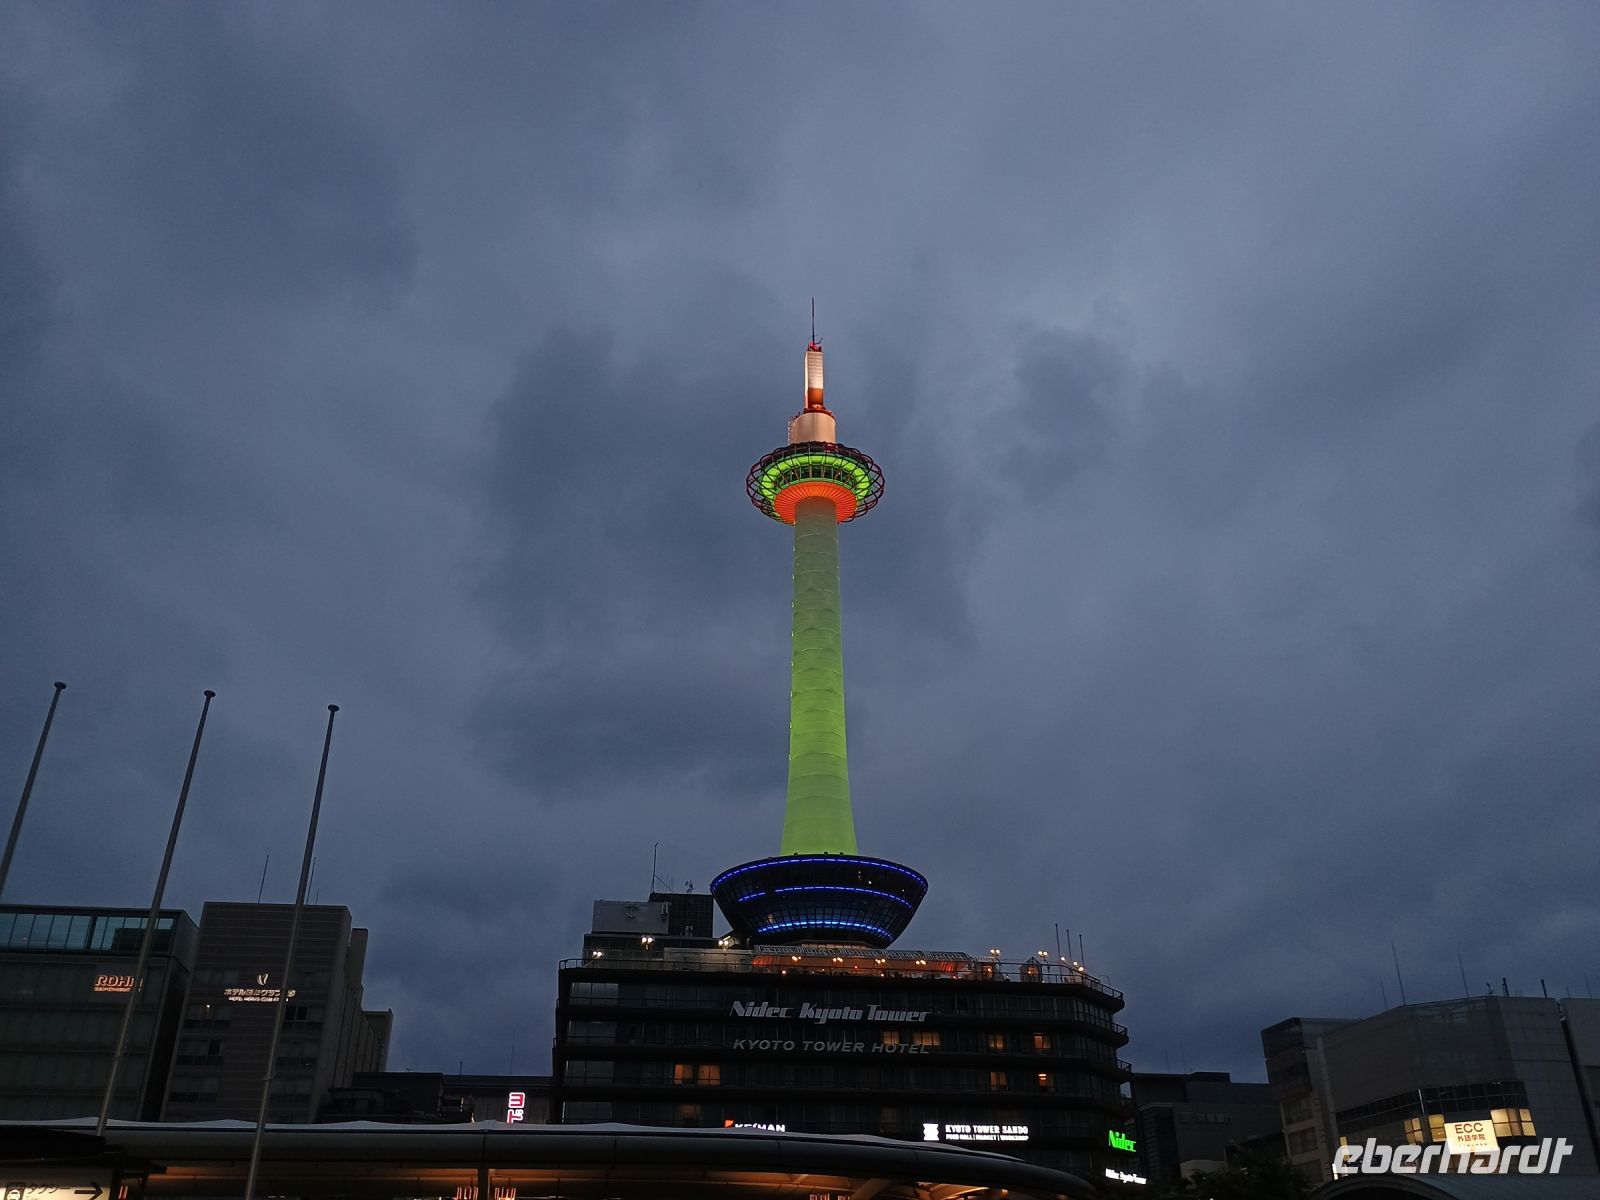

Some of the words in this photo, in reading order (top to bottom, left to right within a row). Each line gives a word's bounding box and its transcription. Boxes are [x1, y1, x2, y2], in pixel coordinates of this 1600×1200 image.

[729, 1000, 794, 1018] Nidec
[799, 1002, 863, 1024] Kyoto
[867, 1004, 931, 1022] Tower
[733, 1039, 795, 1051] KYOTO
[802, 1041, 864, 1053] TOWER
[871, 1043, 929, 1055] HOTEL
[945, 1125, 971, 1133] KYOTO
[973, 1125, 1000, 1133] TOWER
[1002, 1126, 1028, 1134] SANDO
[1455, 1122, 1484, 1134] ECC
[1109, 1130, 1136, 1152] Nidec
[28, 1184, 71, 1194] タクシー
